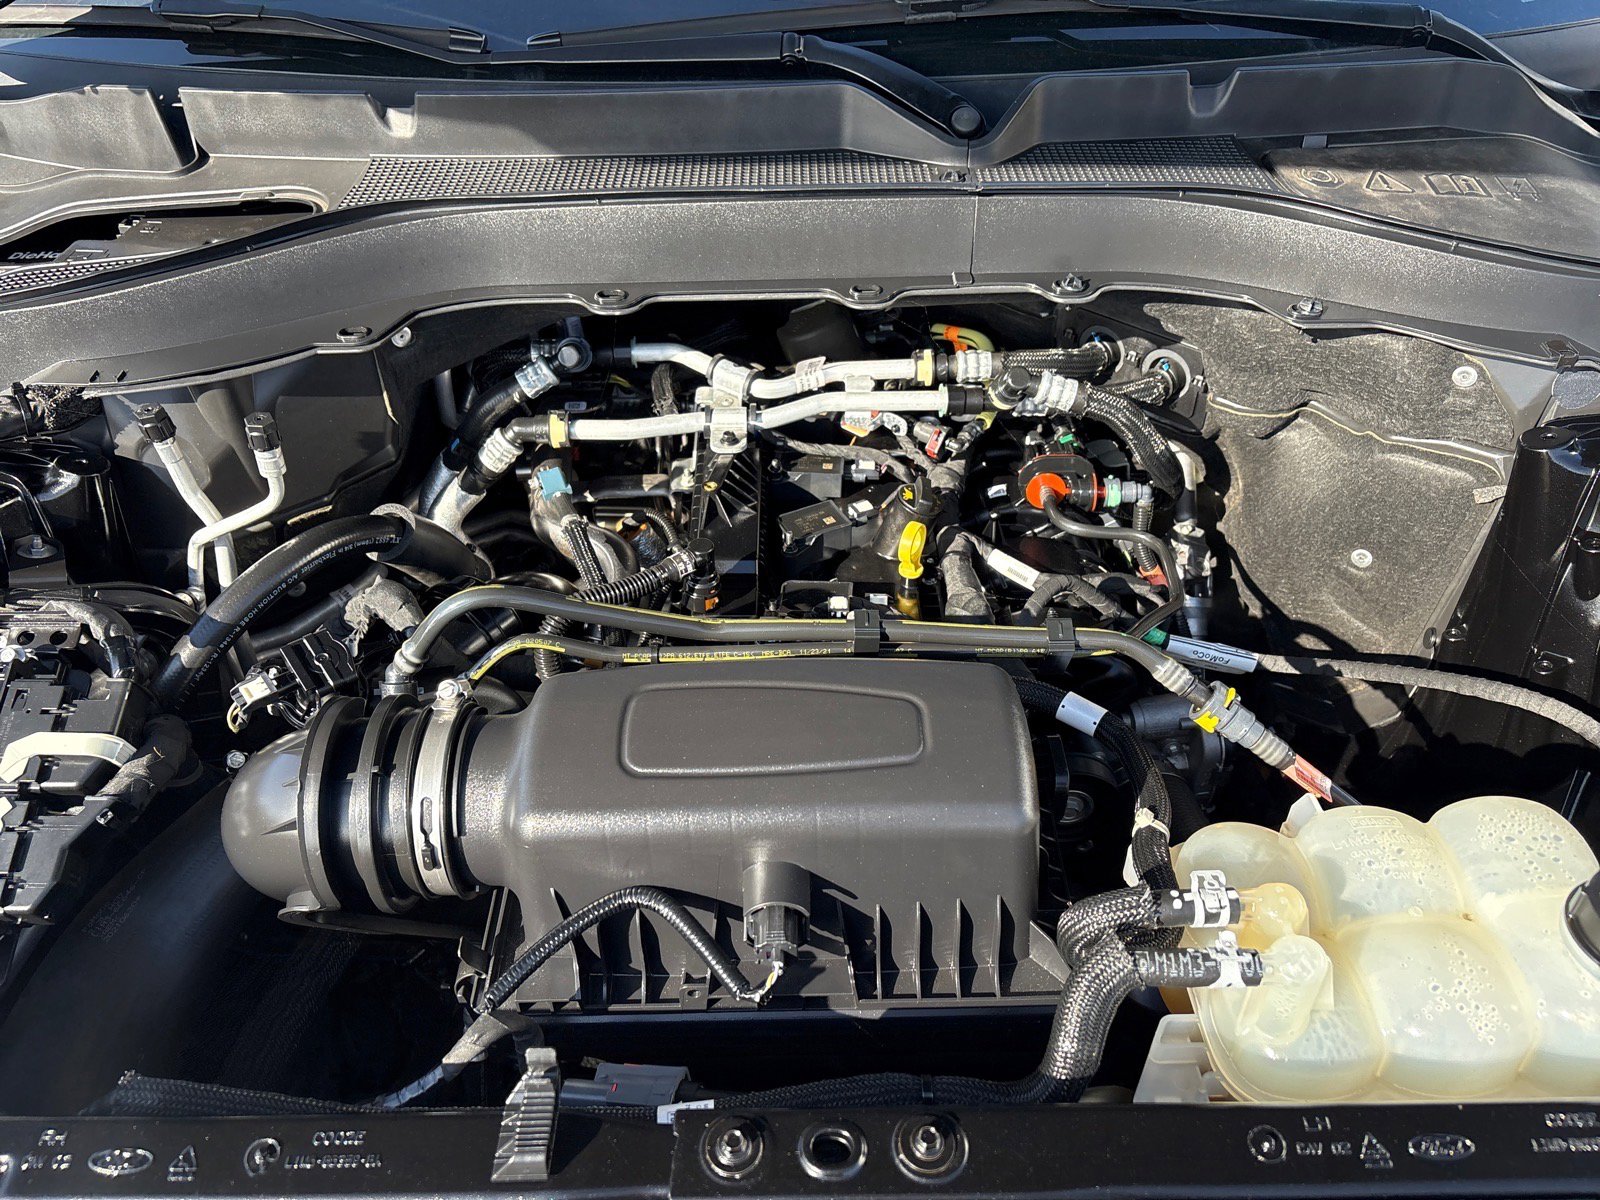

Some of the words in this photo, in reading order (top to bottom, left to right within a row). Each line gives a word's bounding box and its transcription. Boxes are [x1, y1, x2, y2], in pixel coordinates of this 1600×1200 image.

[8, 250, 59, 260] DieHa
[258, 583, 287, 609] SUCTION
[238, 607, 259, 627] HOSE
[1192, 648, 1230, 667] FoMoCo
